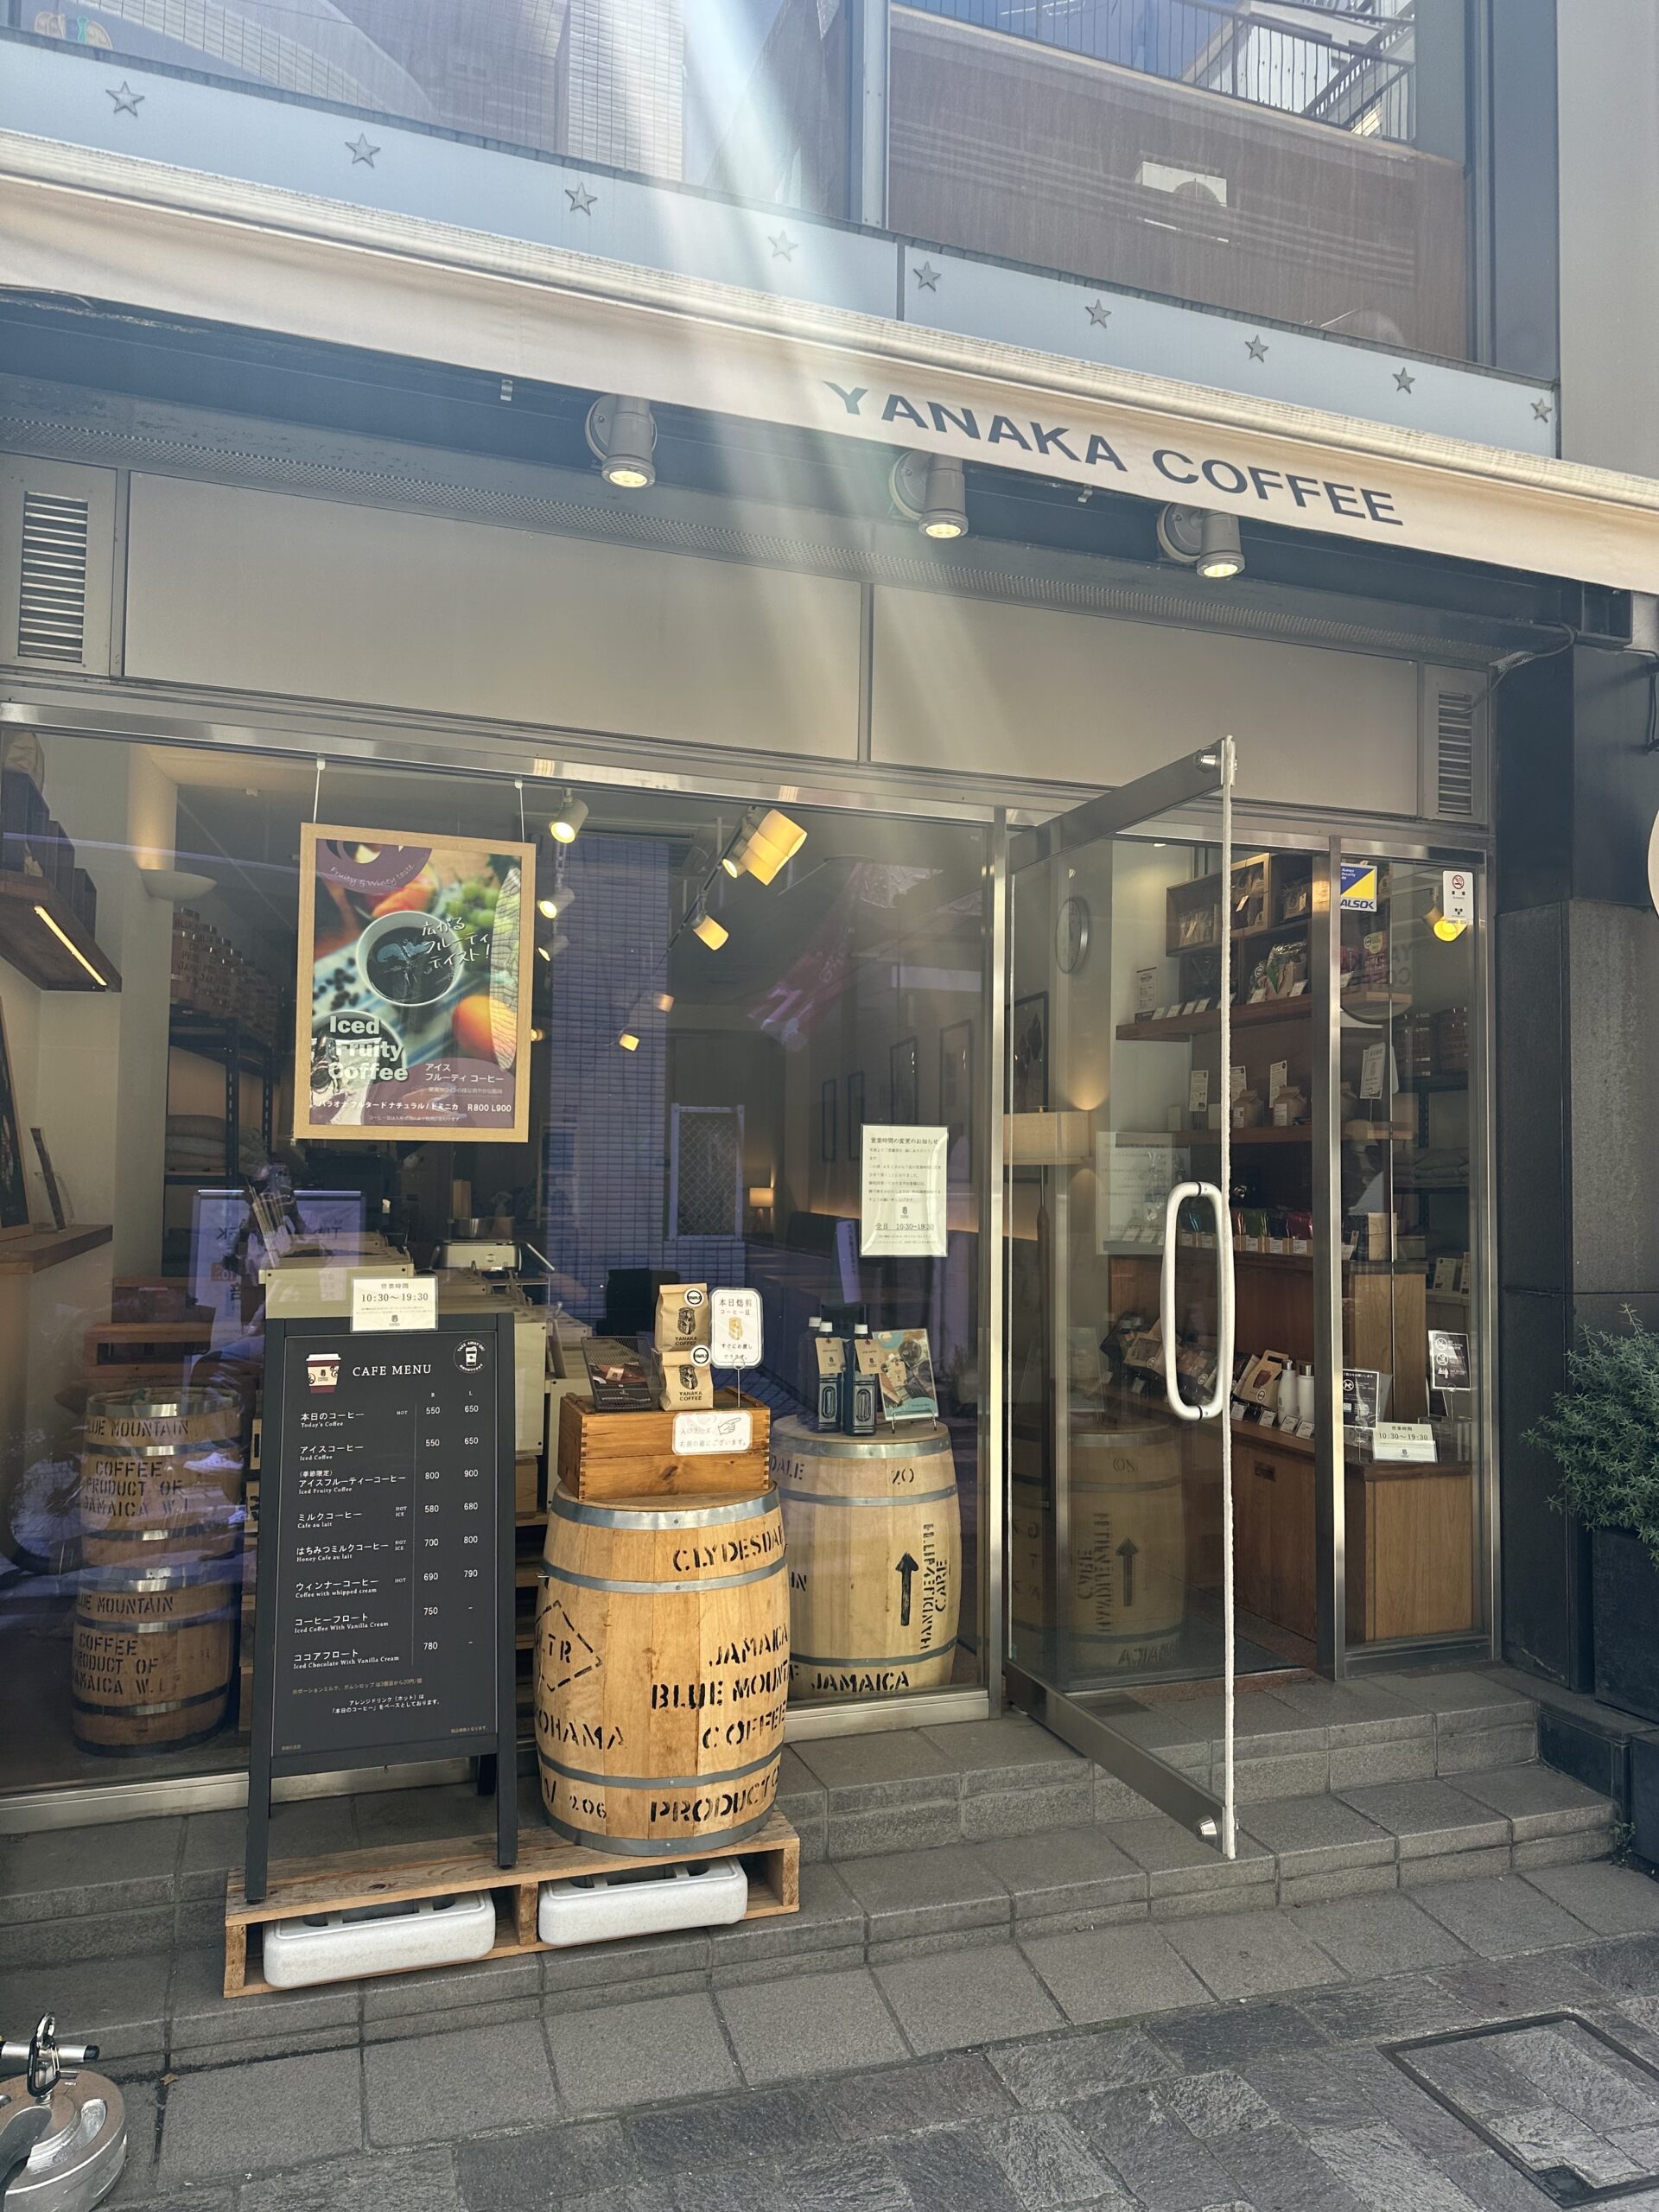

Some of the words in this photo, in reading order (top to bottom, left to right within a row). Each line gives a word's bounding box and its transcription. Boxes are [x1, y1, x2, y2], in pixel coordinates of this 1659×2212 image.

[823, 381, 1128, 473] YANAKA
[1152, 448, 1404, 526] COFFEE
[1340, 899, 1374, 910] ALSOK
[422, 917, 466, 937] 広がる
[329, 1015, 380, 1034] Iced
[335, 1039, 404, 1062] Fruity
[328, 1062, 409, 1081] Coffee
[425, 1063, 451, 1072] アイス
[424, 1073, 467, 1083] フルーティ
[470, 1074, 505, 1083] コーヒー
[389, 1102, 425, 1110] ナチュラル
[467, 1103, 490, 1112] R800
[491, 1104, 512, 1113] L900
[353, 1366, 387, 1376] CAFE
[391, 1364, 432, 1376] MENU
[300, 1411, 365, 1421] 本日のコーヒー
[111, 1420, 188, 1438] MOUNTAIN
[300, 1445, 364, 1455] アイスコーヒー
[95, 1460, 162, 1478] COFFEE
[160, 1480, 183, 1496] OF
[298, 1475, 406, 1488] アイスフルーティーコーヒー
[298, 1511, 363, 1522] ミルクコーヒー
[464, 1502, 479, 1510] 680
[296, 1542, 389, 1556] はちみつミルクコーヒー
[424, 1538, 439, 1547] 700
[463, 1535, 479, 1544] 800
[296, 1579, 379, 1592] ウィンナーコーヒー
[463, 1569, 479, 1578] 790
[935, 1559, 948, 1613] CARE
[331, 1588, 358, 1597] whipped
[97, 1596, 173, 1614] MOUNTAIN
[295, 1612, 368, 1626] コーヒーフロート
[423, 1606, 438, 1615] 750
[79, 1633, 138, 1656] COFFEE
[294, 1649, 359, 1662] ココアフロート
[423, 1641, 438, 1649] 780
[709, 1623, 789, 1667] JAMAICA
[136, 1657, 159, 1675] OF
[811, 1671, 910, 1693] JAMAICA
[652, 1680, 724, 1710] BLUE
[702, 1700, 786, 1750] COFFEE
[569, 1796, 607, 1820] 206
[650, 1774, 771, 1823] PRODUCT
